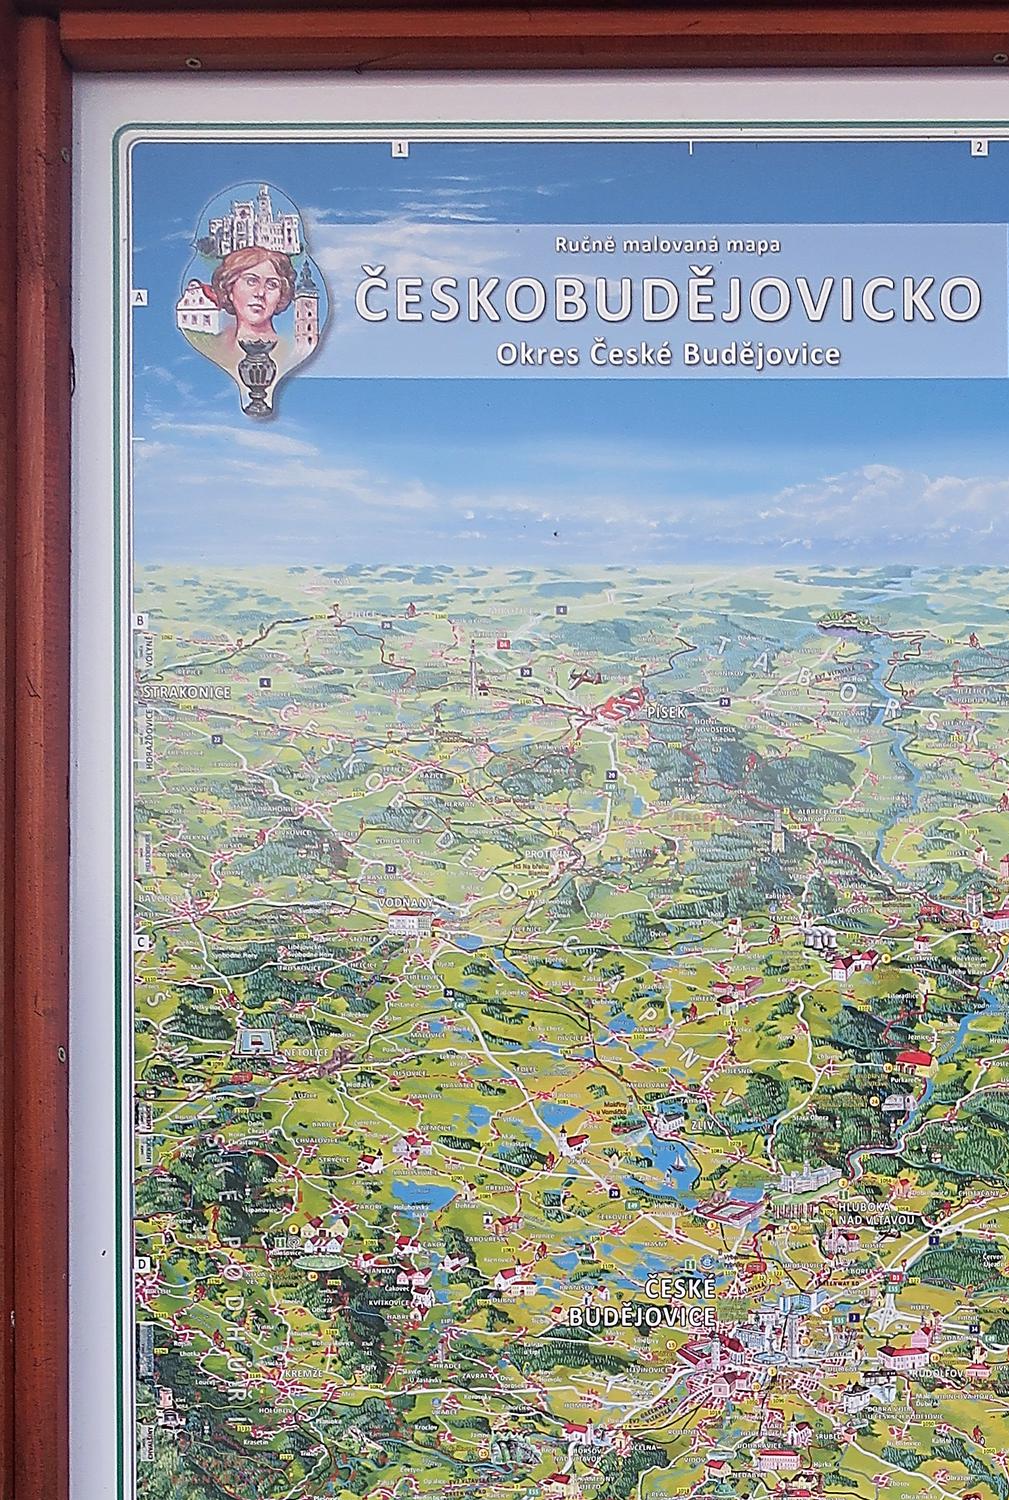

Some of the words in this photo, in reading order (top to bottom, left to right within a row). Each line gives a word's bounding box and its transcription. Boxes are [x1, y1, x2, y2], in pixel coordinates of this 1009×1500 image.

[398, 143, 403, 154] 1
[976, 141, 982, 152] 2
[556, 236, 614, 256] Ručně
[624, 235, 718, 252] malovaná
[727, 240, 780, 256] mapa
[135, 292, 144, 302] A
[352, 264, 980, 323] ČESKOBUDĚJOVICKO
[497, 342, 578, 368] Okres
[591, 337, 671, 364] České
[685, 341, 839, 369] Budějovice
[143, 685, 232, 699] STRAKONICE
[647, 703, 686, 719] PÍSEK
[379, 895, 434, 908] VODŇANY
[284, 1048, 329, 1057] NETOLICE
[839, 1215, 863, 1225] NAD
[866, 1215, 915, 1225] VLTAVOU
[645, 1273, 716, 1299] ČESKÉ
[569, 1301, 716, 1327] BUDĚJOVICE
[912, 1369, 963, 1378] RUDOLFOV
